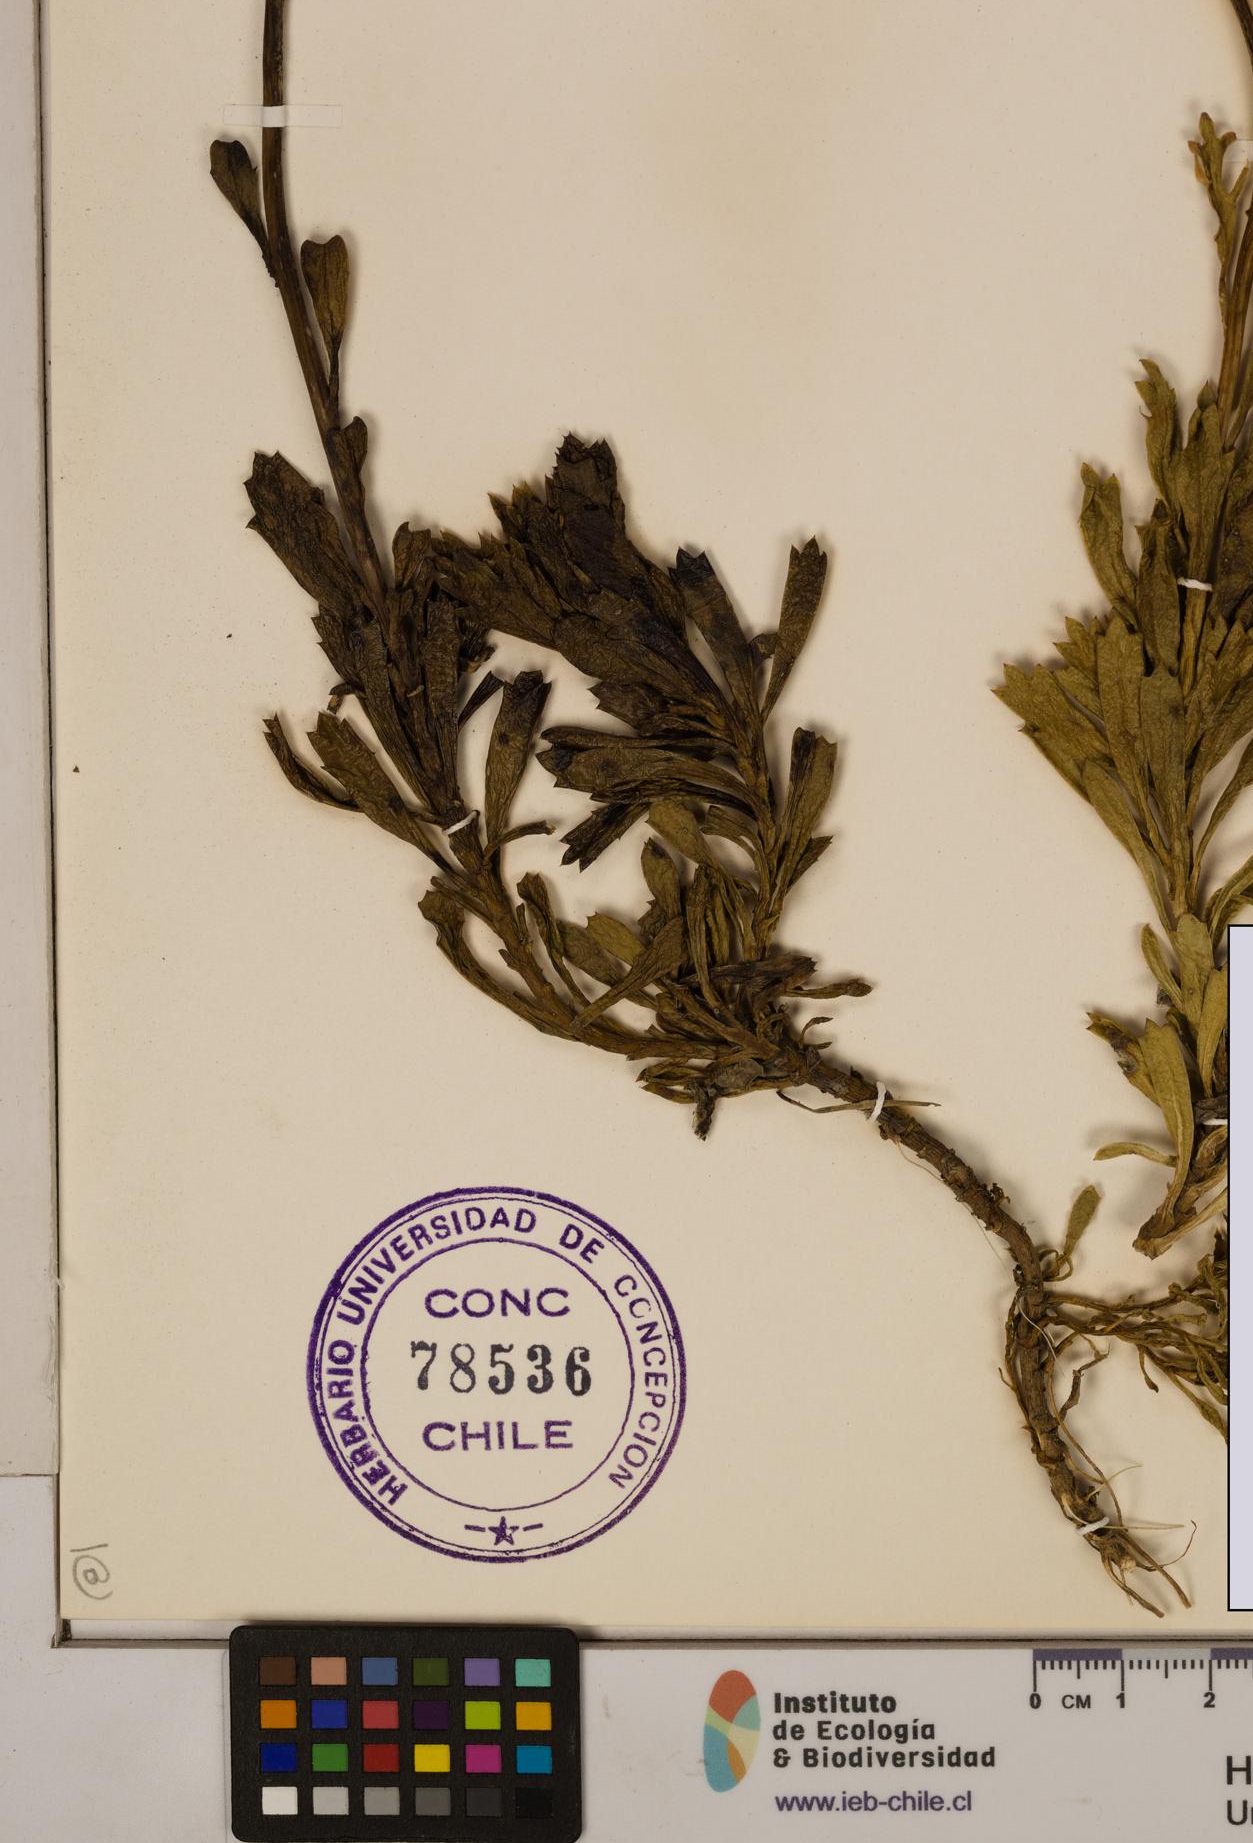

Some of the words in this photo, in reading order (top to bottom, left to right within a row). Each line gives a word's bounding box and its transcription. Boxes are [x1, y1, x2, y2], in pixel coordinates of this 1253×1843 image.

[559, 1223, 606, 1266] DE
[336, 1206, 538, 1326] UNIVERSIDAD
[424, 1287, 571, 1319] CONC
[410, 1340, 592, 1397] 78536
[326, 1338, 409, 1506] HERBARIO
[422, 1419, 573, 1452] CHILE
[773, 1690, 898, 1714] Instituto
[1029, 1693, 1042, 1710] 0
[1061, 1694, 1092, 1710] CM
[1115, 1692, 1126, 1709] 1
[1203, 1691, 1216, 1709] 2
[772, 1719, 806, 1742] de
[816, 1718, 937, 1746] Ecología
[772, 1747, 793, 1769] &
[801, 1745, 997, 1769] Biodiversidad
[773, 1789, 973, 1813] www.ieb-chile.cl
